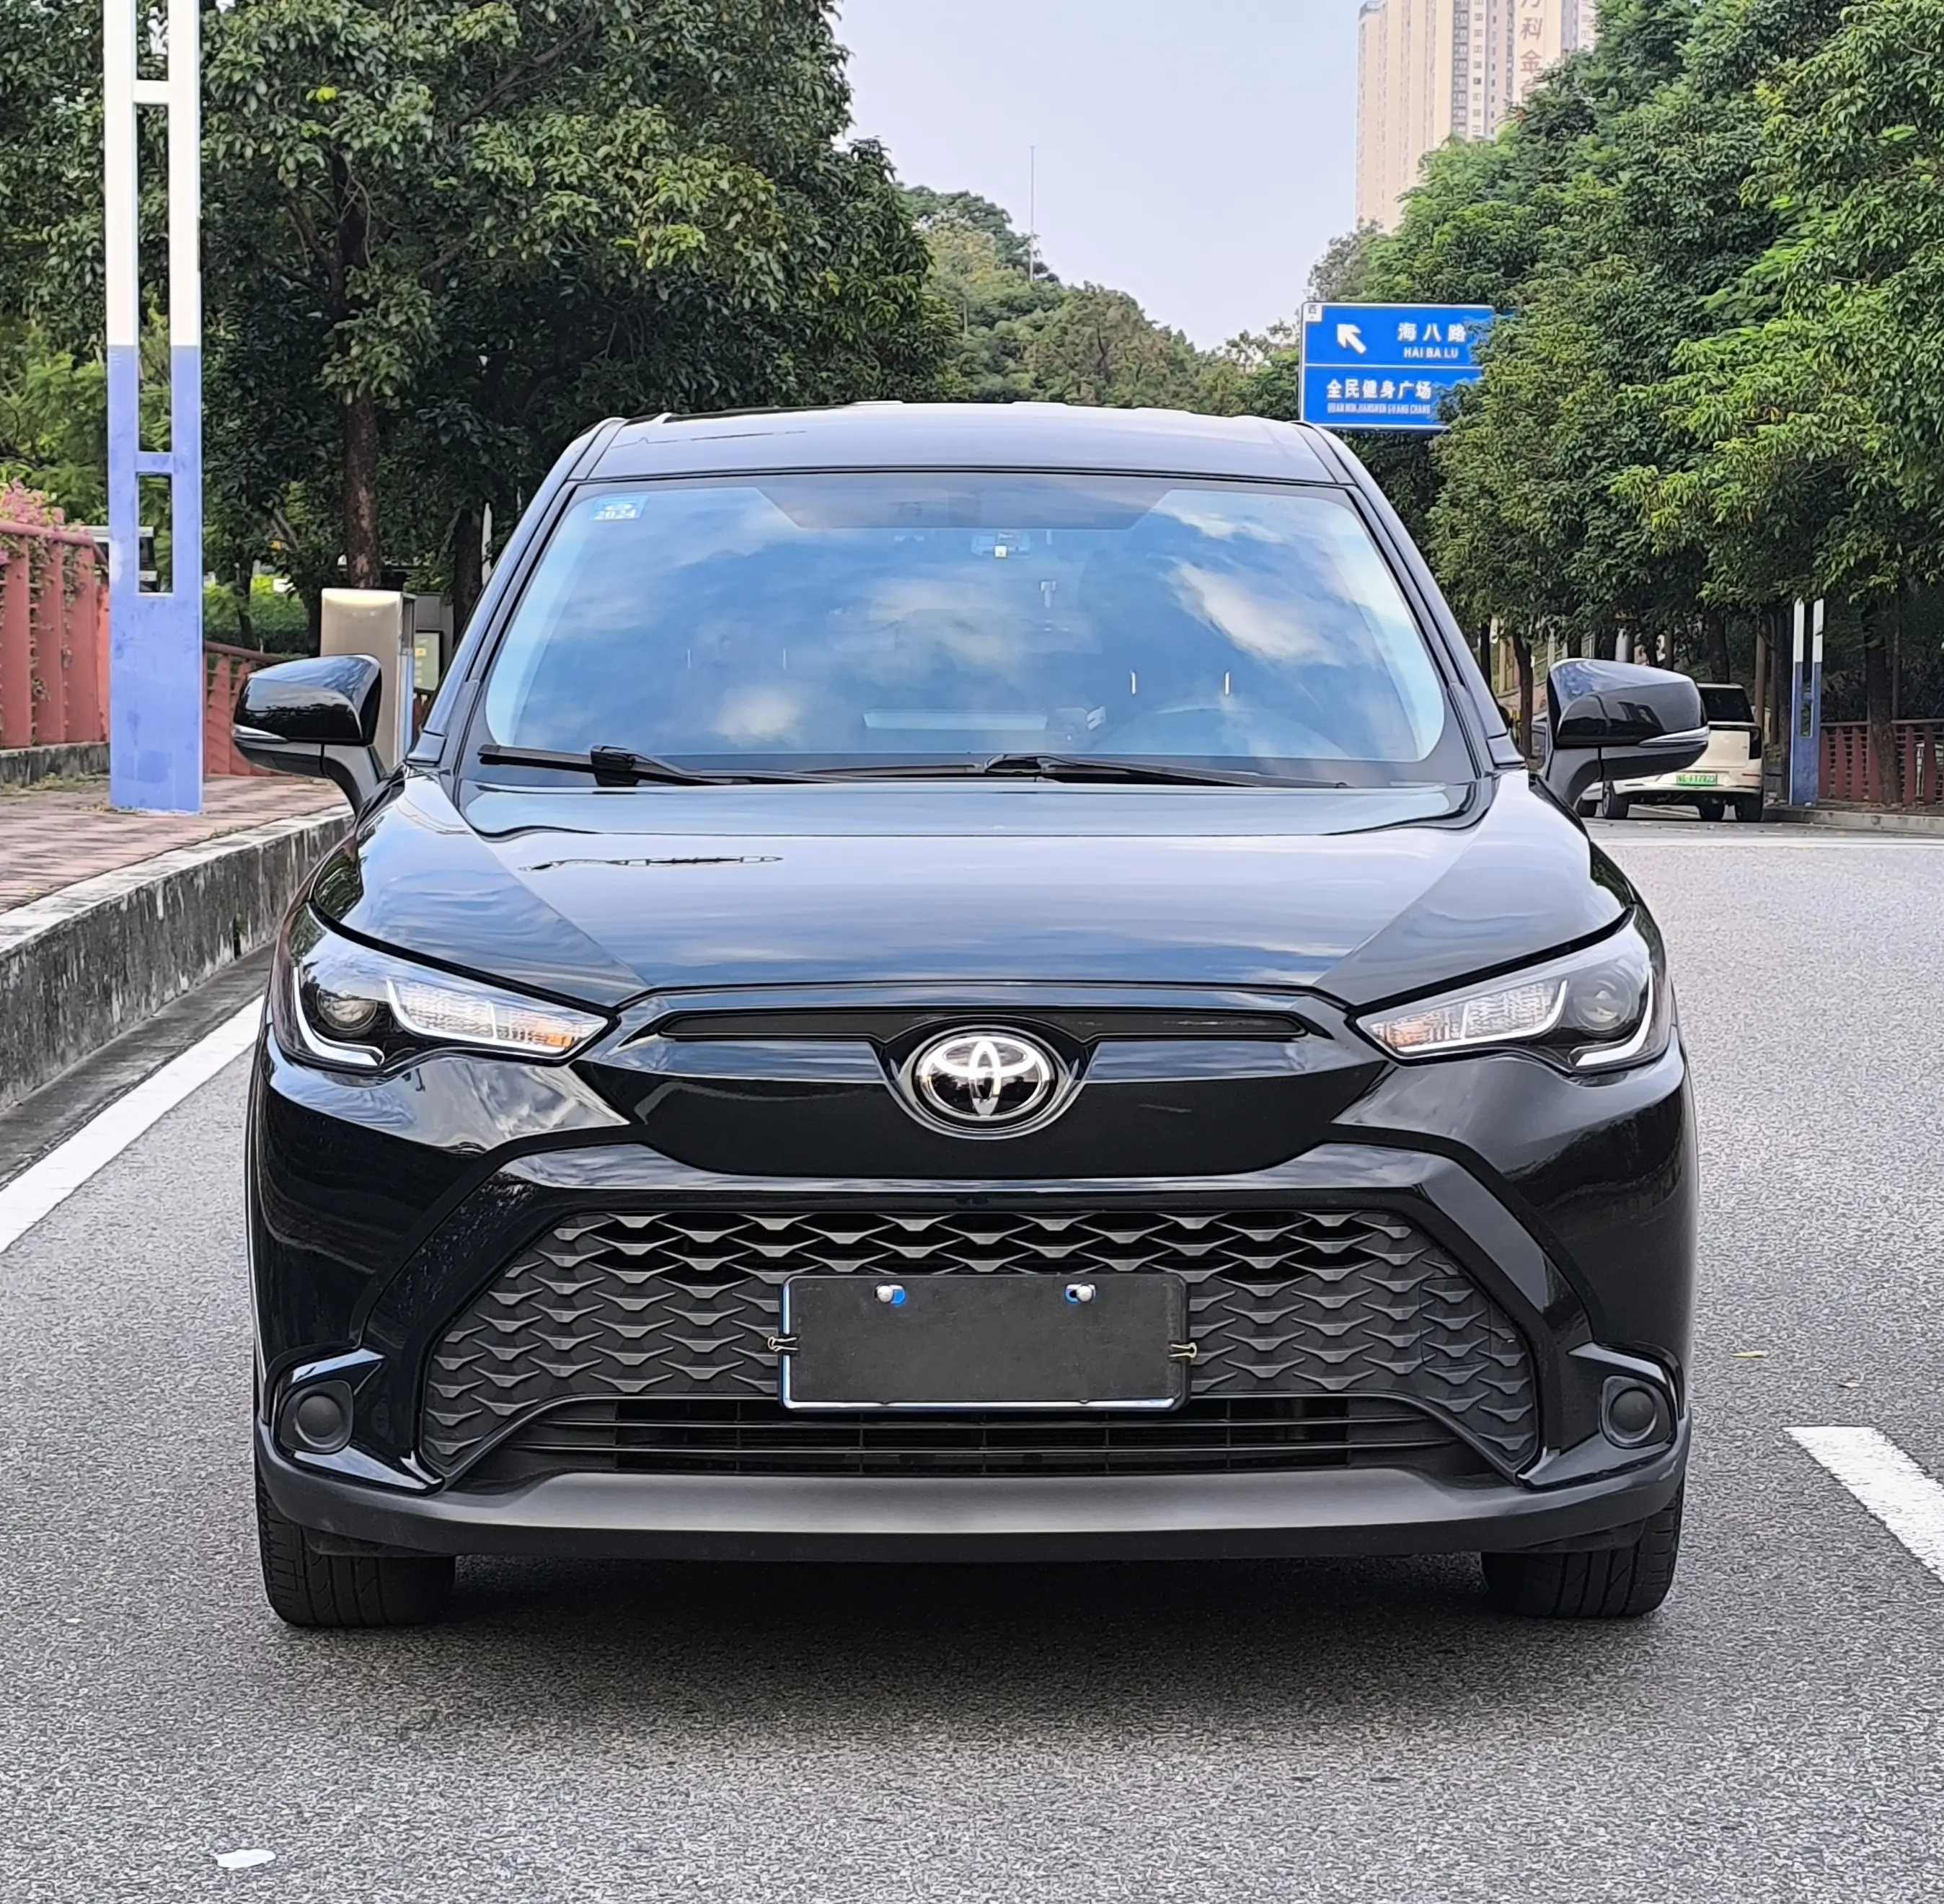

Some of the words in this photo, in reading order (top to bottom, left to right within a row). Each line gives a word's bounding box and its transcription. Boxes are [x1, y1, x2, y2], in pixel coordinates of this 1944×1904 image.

[1397, 322, 1466, 342] 海八路
[1403, 346, 1423, 358] HAI
[1426, 346, 1442, 358] BA
[1444, 347, 1459, 358] LU
[1326, 378, 1431, 400] 全民健身广场
